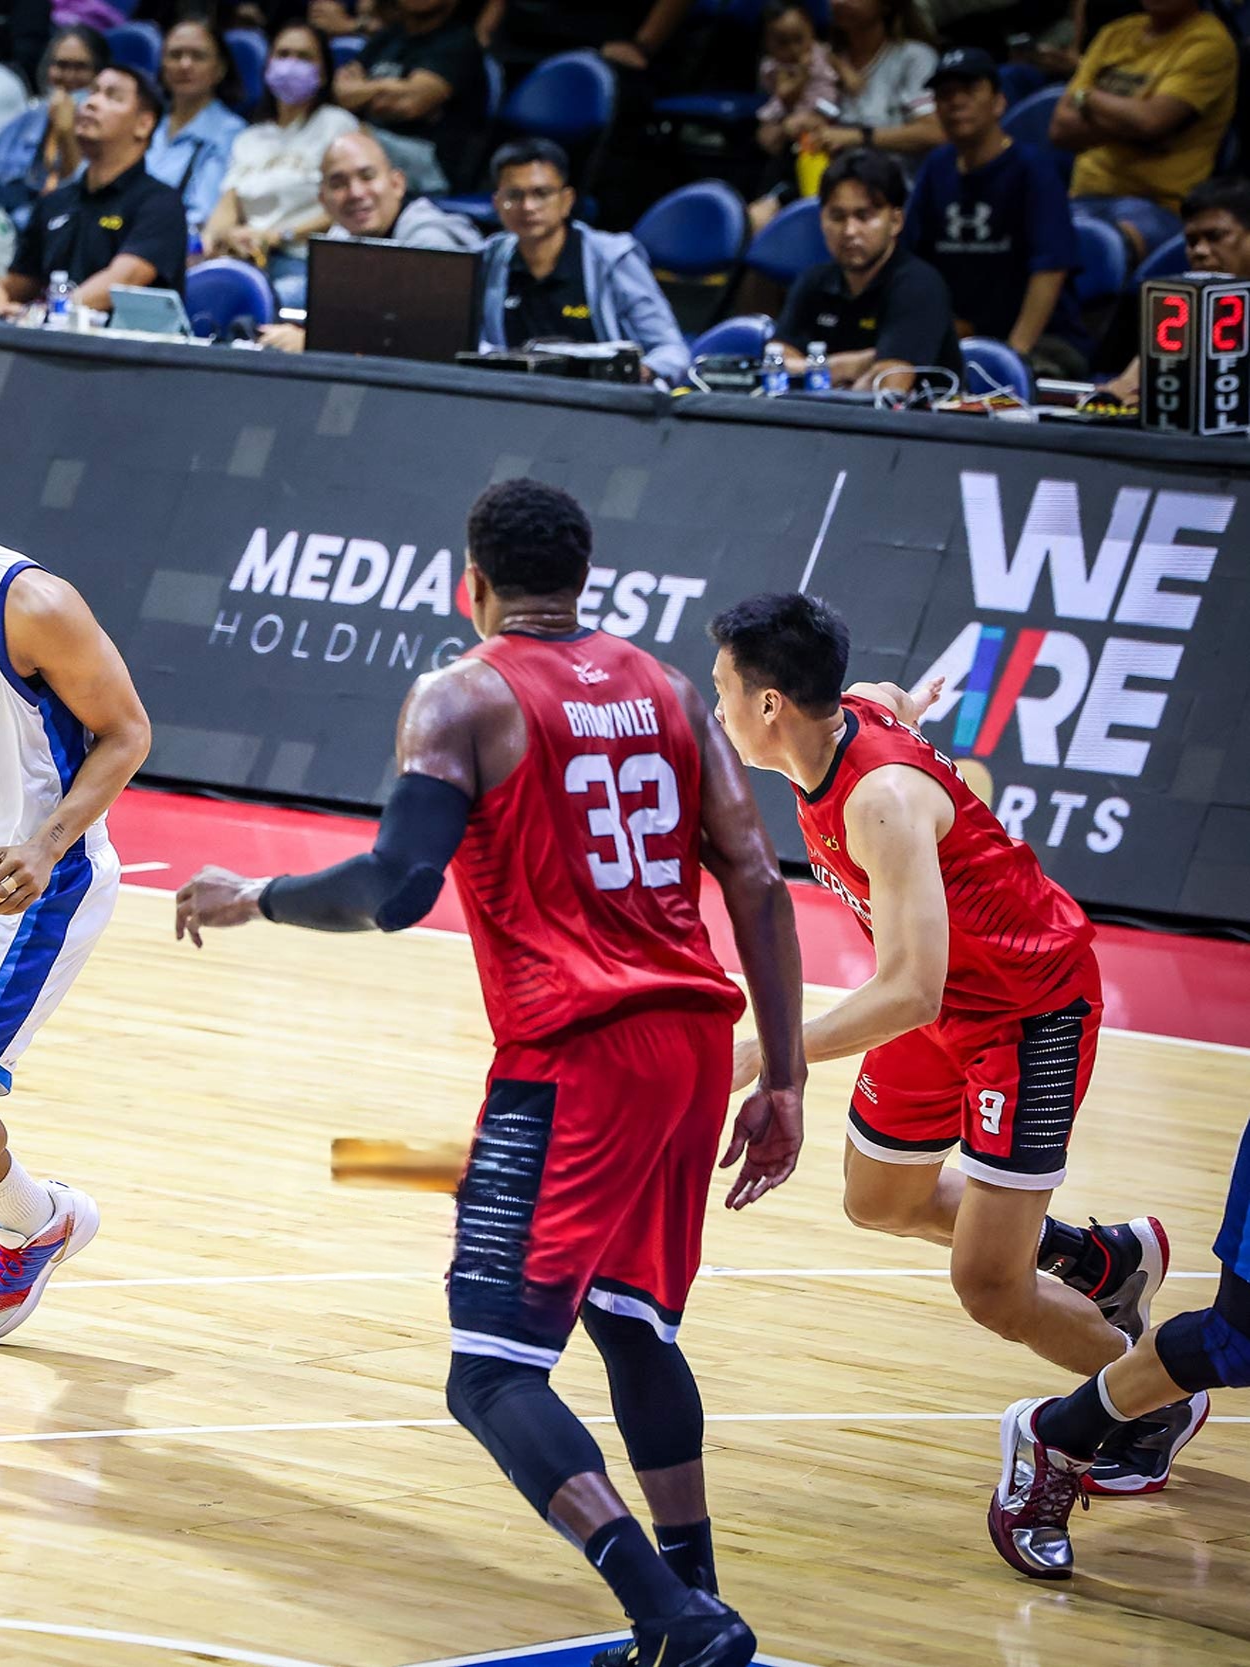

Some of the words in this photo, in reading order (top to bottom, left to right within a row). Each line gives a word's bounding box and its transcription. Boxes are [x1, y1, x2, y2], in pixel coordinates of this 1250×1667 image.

[1156, 294, 1190, 351] 2
[1212, 294, 1244, 350] 2
[1214, 356, 1241, 430] FOUL
[229, 527, 708, 643] MEDIAEST
[959, 469, 1237, 631] WE
[208, 608, 466, 672] HOLDING
[910, 621, 1186, 778] ARE
[564, 753, 682, 891] 32
[977, 1088, 1007, 1135] 9
